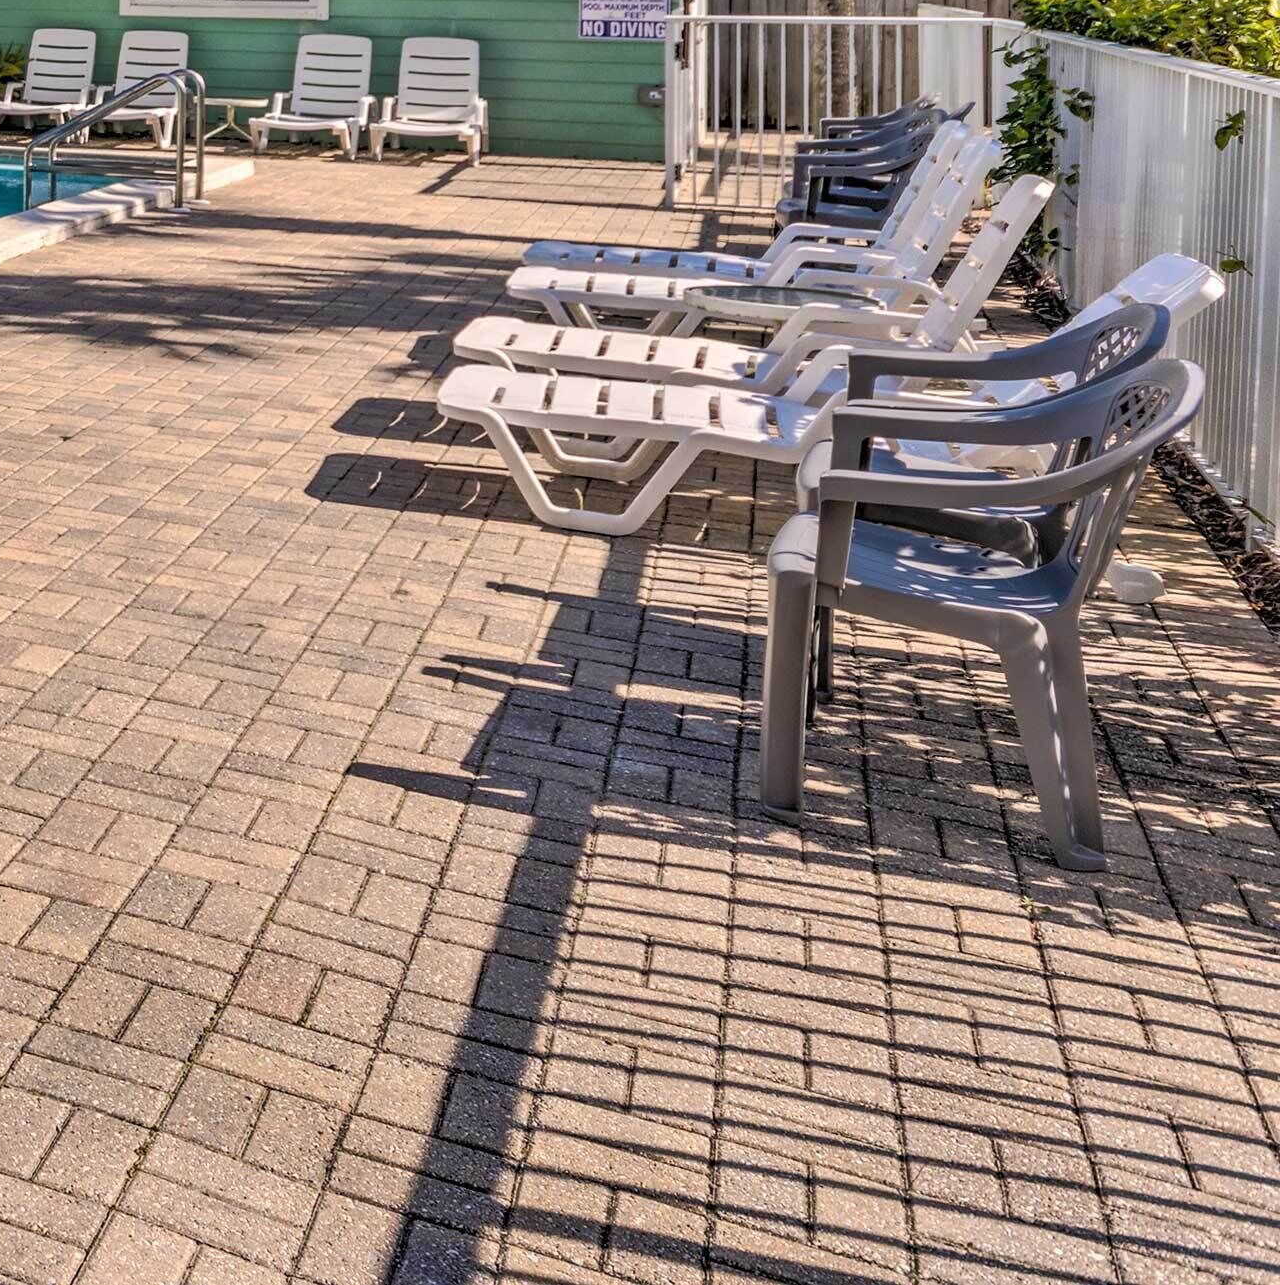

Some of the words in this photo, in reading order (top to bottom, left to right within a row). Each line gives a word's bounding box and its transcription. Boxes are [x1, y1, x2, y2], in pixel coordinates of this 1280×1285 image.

[583, 2, 601, 10] POOL
[604, 3, 639, 11] MAXIMUM
[624, 11, 647, 19] FEET
[582, 20, 605, 36] NO
[609, 21, 666, 37] DIVING
